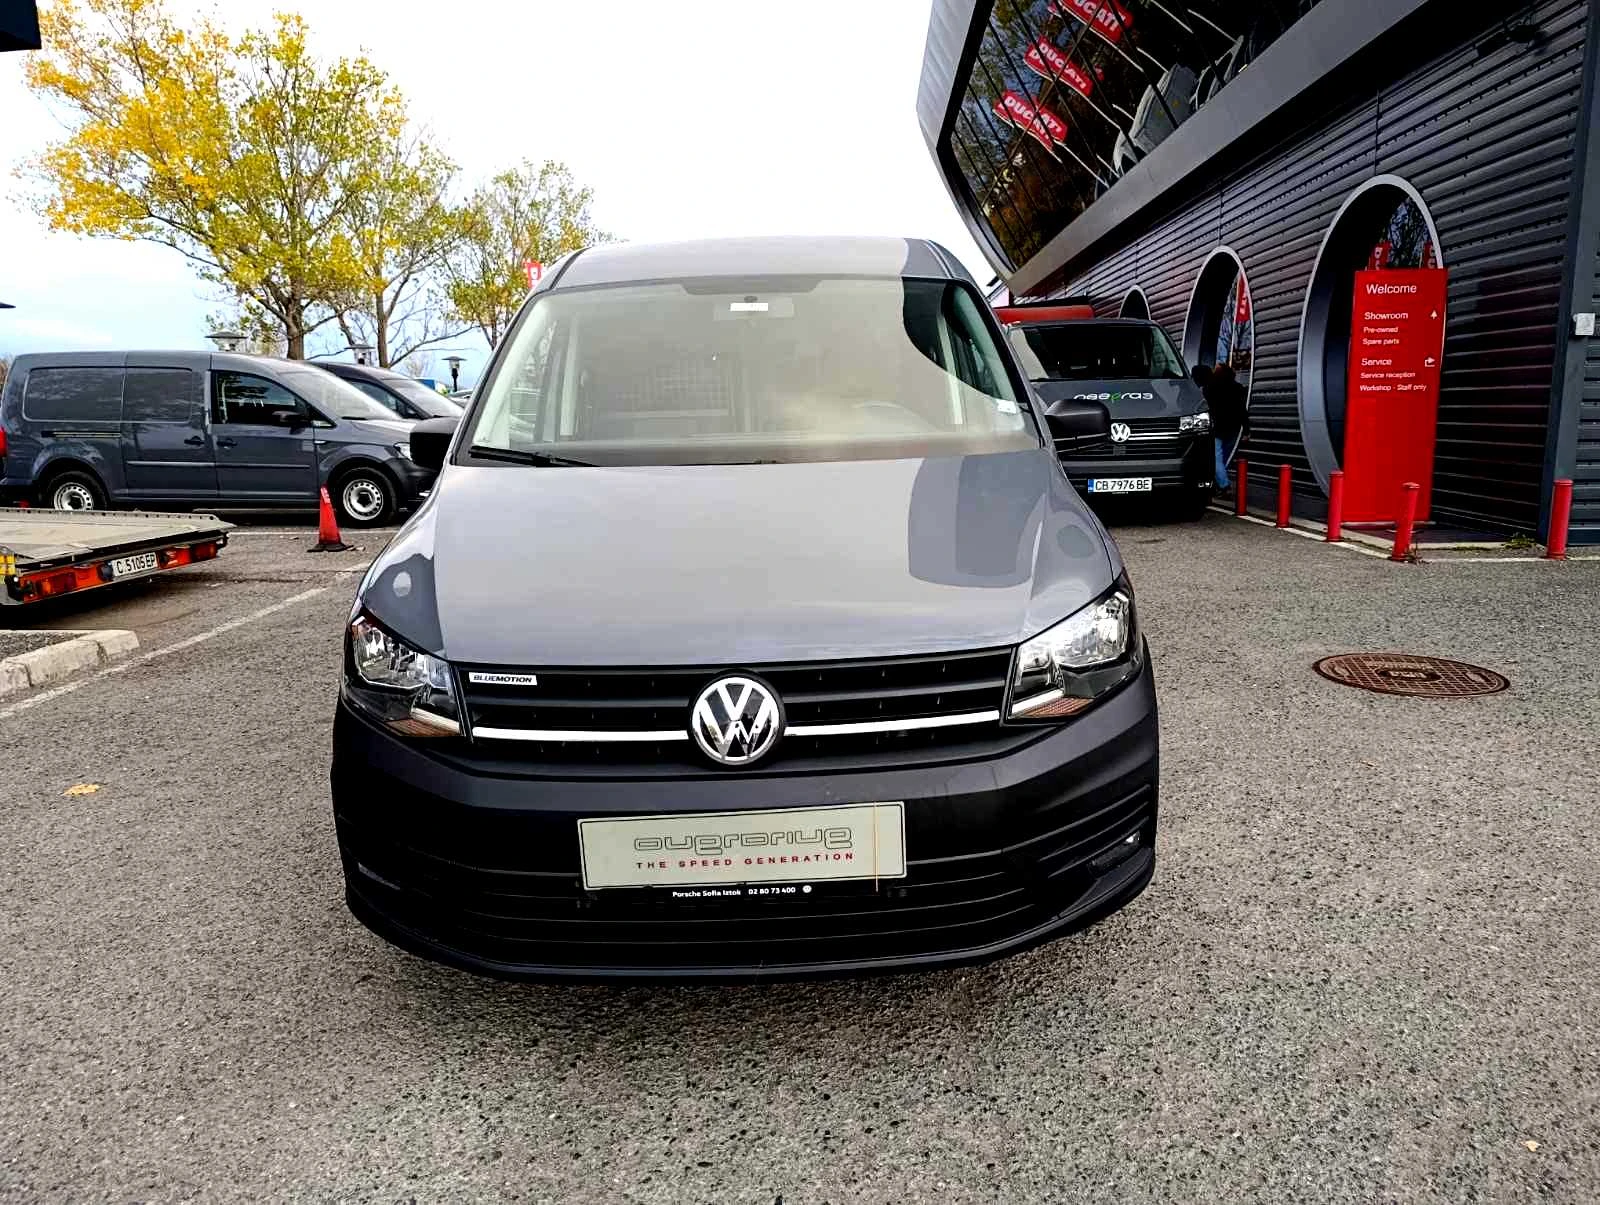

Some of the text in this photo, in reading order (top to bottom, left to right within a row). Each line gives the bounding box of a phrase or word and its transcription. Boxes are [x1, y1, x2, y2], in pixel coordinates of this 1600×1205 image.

[1037, 41, 1087, 89] DUCATI
[1003, 95, 1063, 133] DUCATI
[1366, 284, 1417, 295] Welcome
[1364, 311, 1409, 320] Showroom
[1362, 338, 1382, 346] Spare
[1361, 358, 1392, 366] Service
[1386, 371, 1416, 380] reception
[1359, 384, 1392, 392] Workshop
[1413, 383, 1427, 392] only
[1110, 479, 1135, 491] 7976
[125, 556, 146, 572] 5105
[473, 674, 533, 684] BLUEMOTION
[636, 851, 854, 870] THE SPEED GENERATION
[672, 890, 701, 898] Porsche
[781, 886, 796, 894] 400
